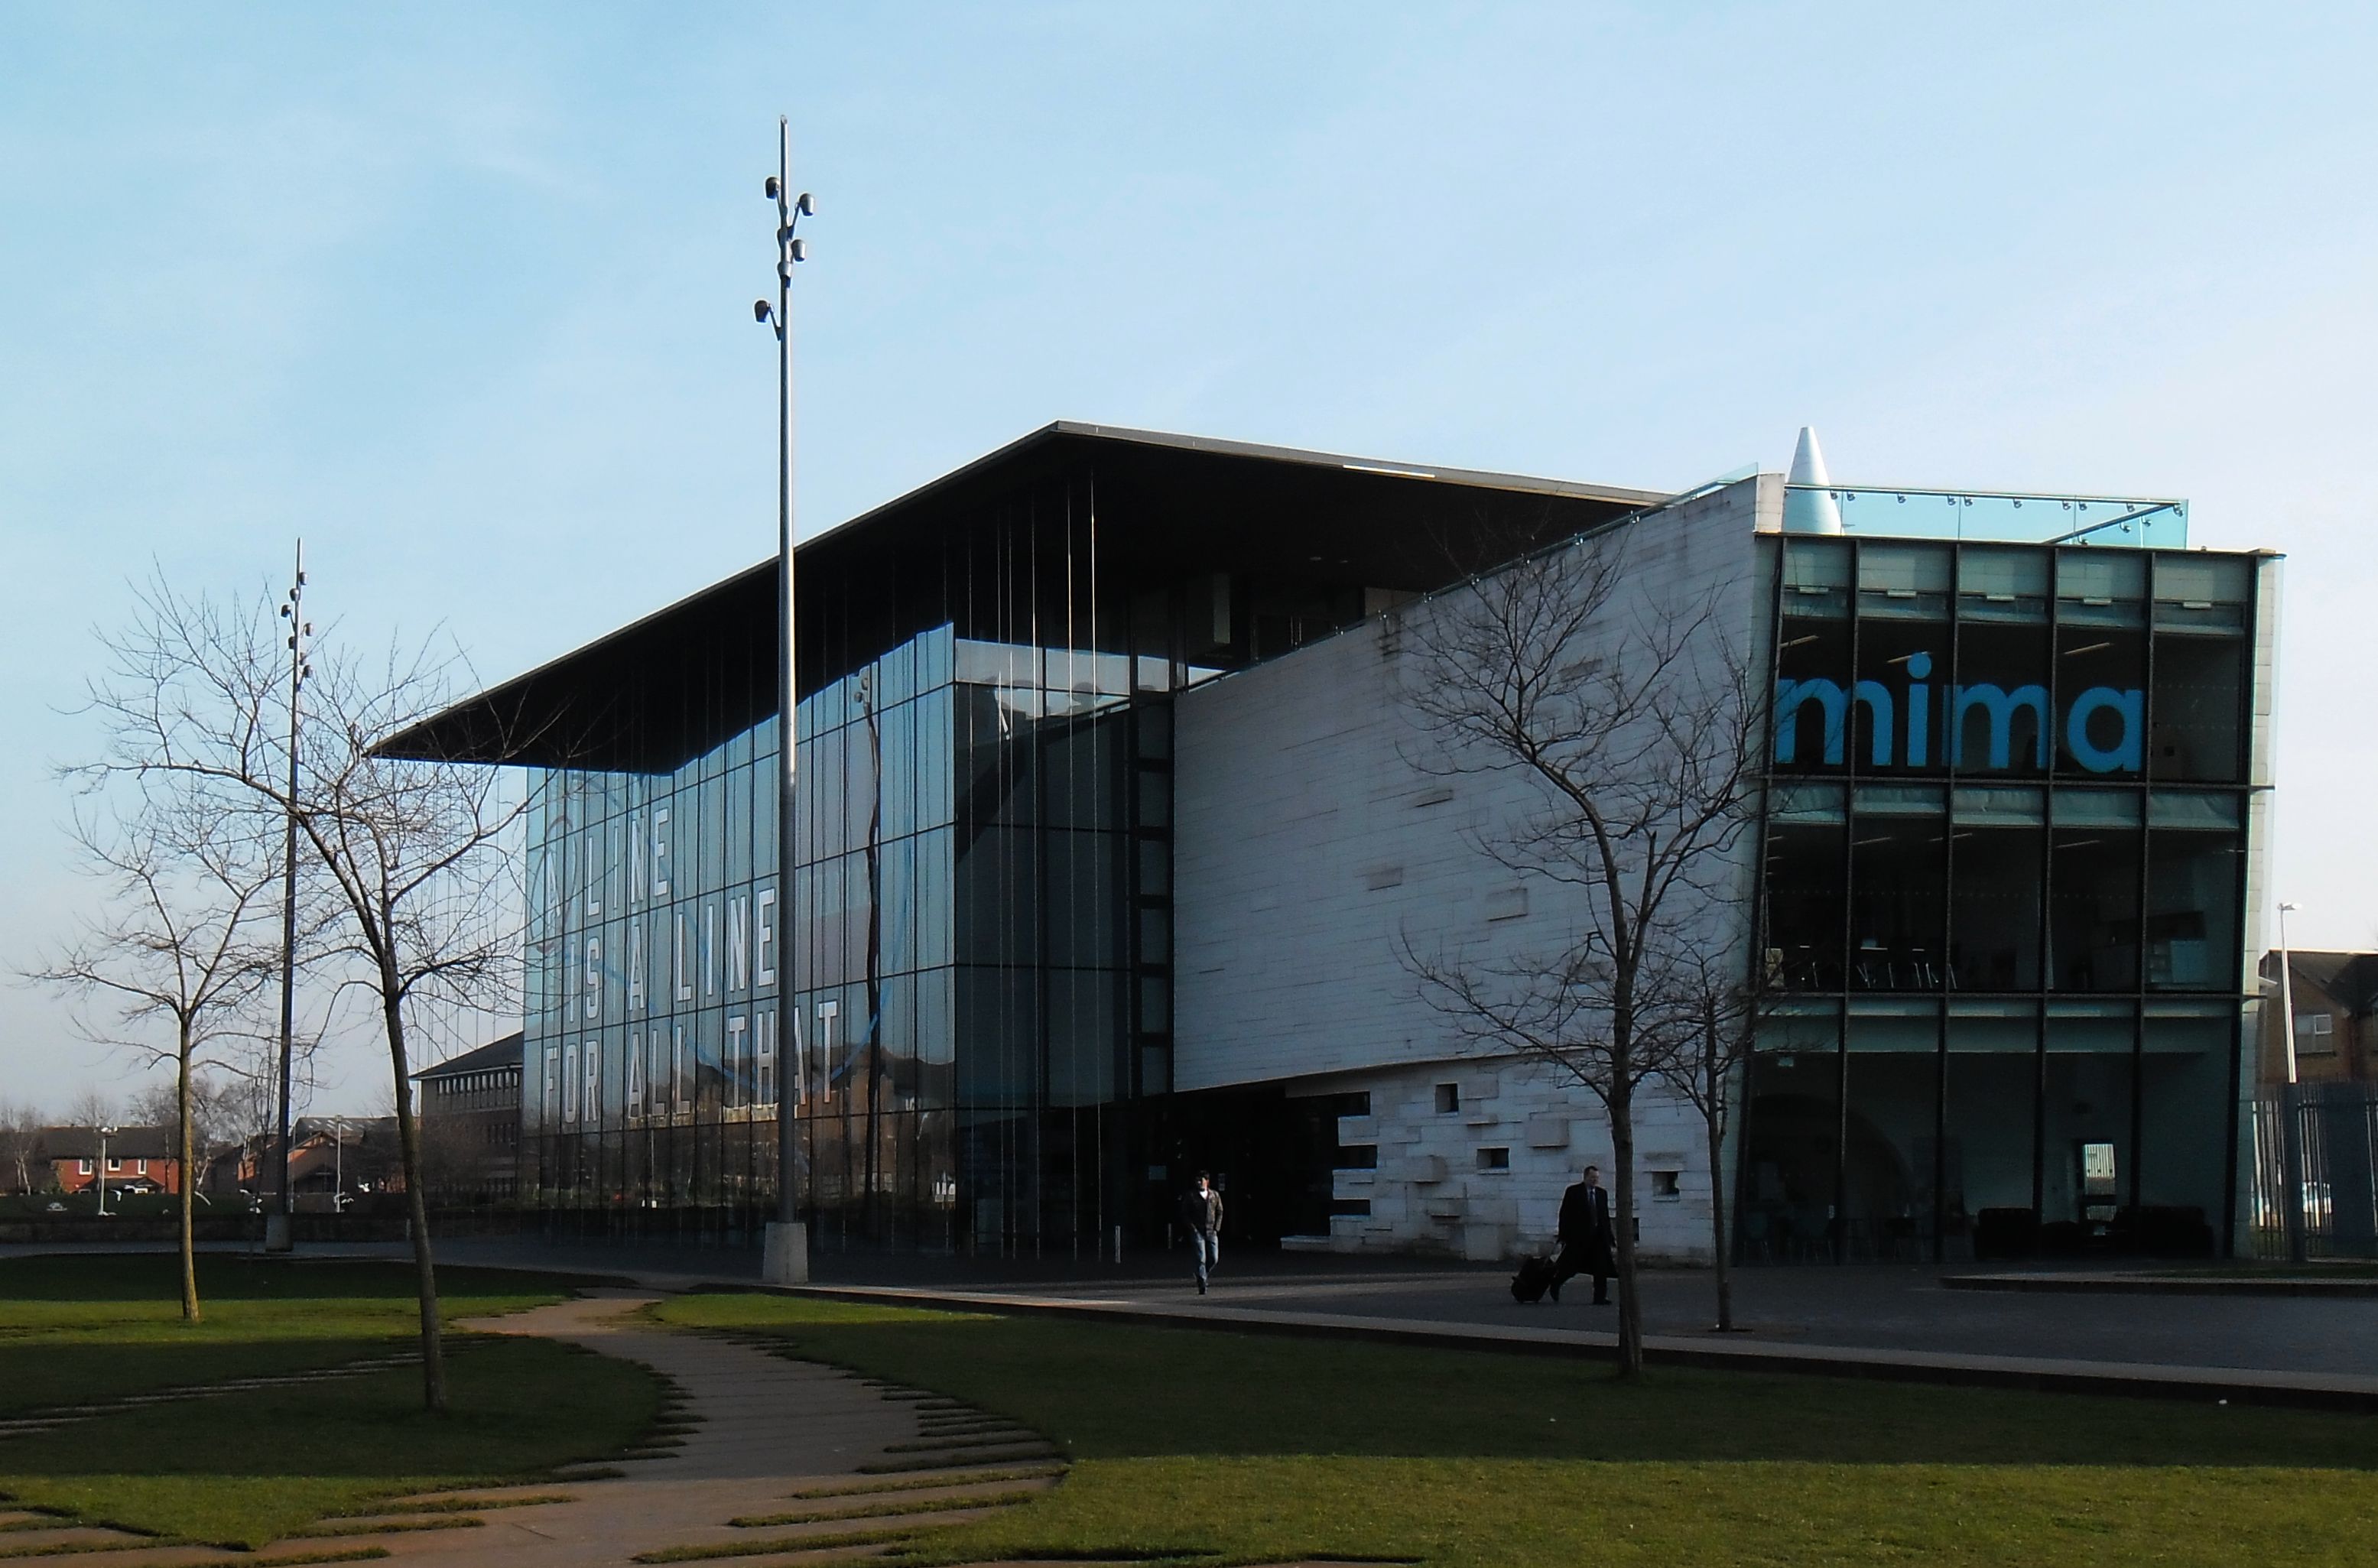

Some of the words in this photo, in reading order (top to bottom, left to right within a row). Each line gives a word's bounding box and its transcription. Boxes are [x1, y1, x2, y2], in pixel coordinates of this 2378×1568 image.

[1774, 651, 2146, 773] mima
[546, 850, 560, 930] A
[587, 808, 669, 917] LINE
[569, 937, 599, 1023] IS
[630, 922, 645, 1011] A
[677, 888, 775, 1002] LINE
[545, 1040, 599, 1125] FOR
[628, 1025, 690, 1118] ALL
[729, 1002, 837, 1109] THAT
